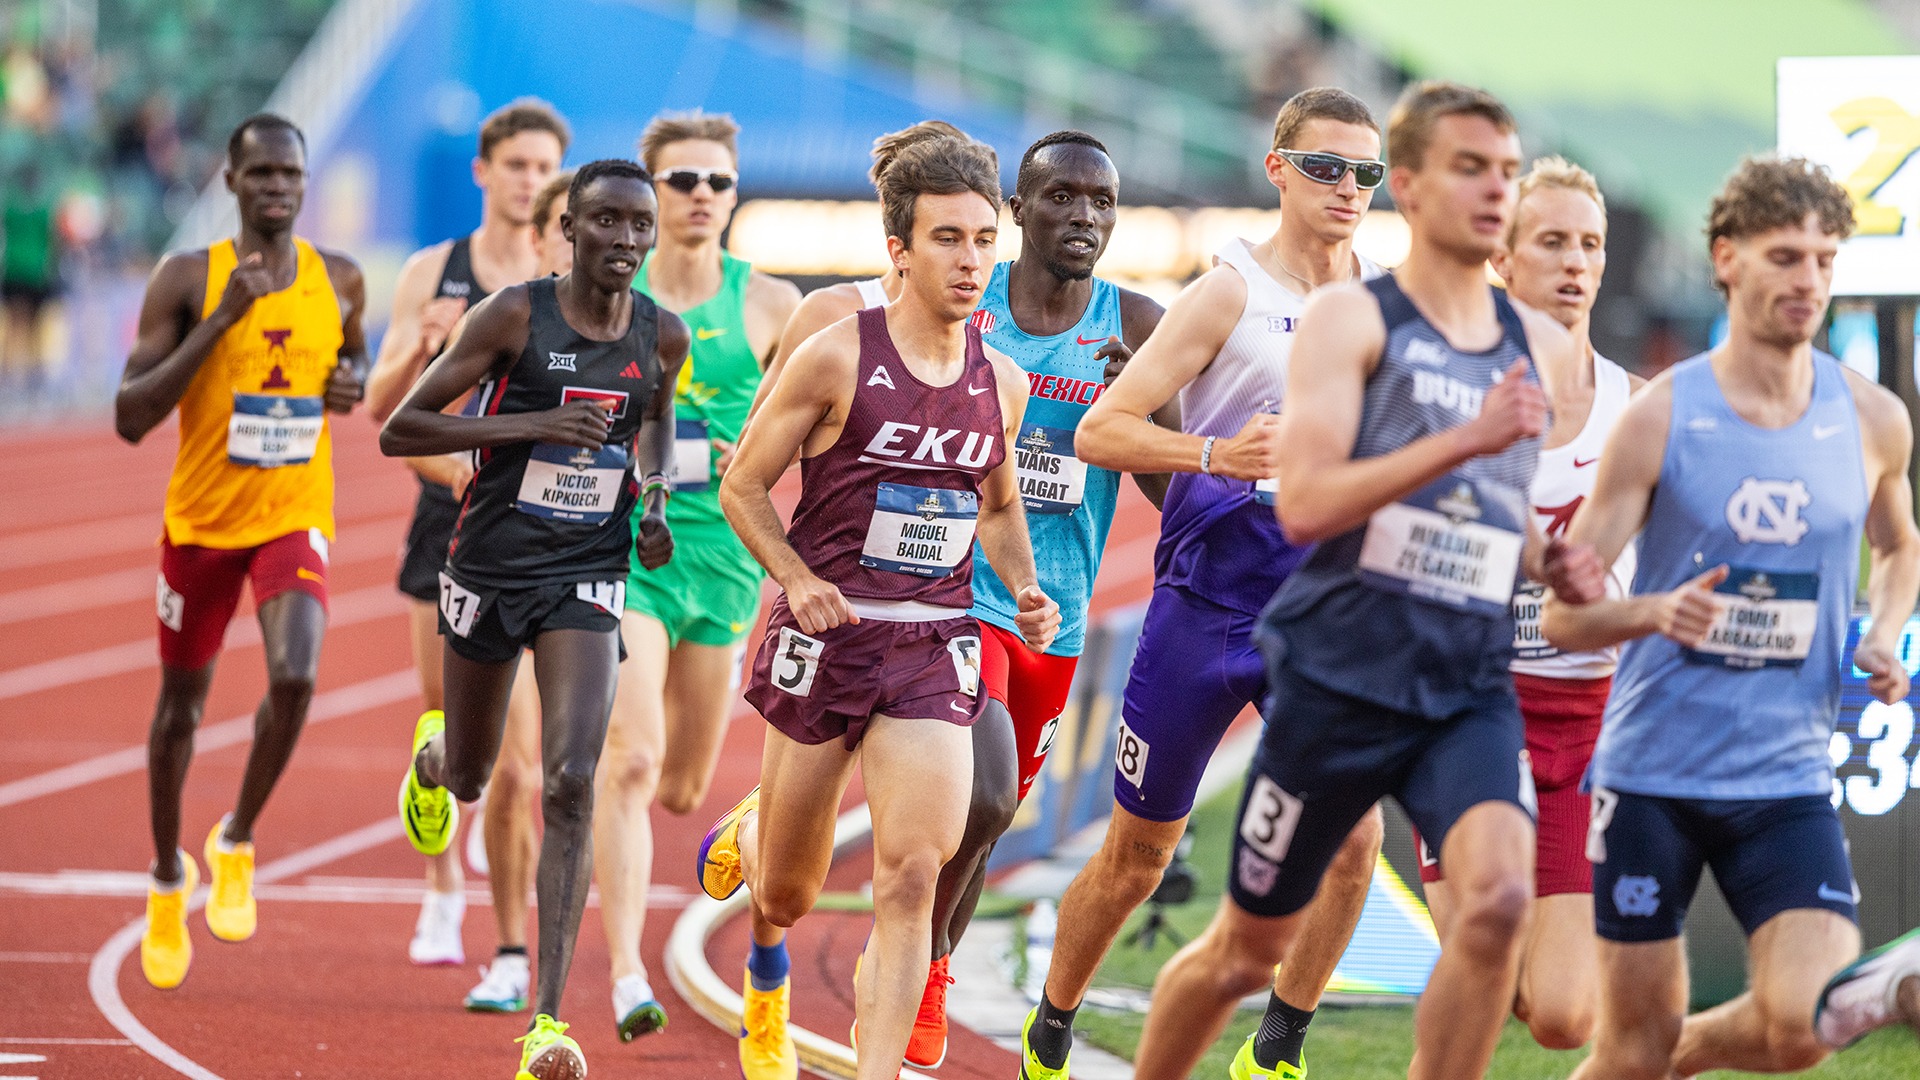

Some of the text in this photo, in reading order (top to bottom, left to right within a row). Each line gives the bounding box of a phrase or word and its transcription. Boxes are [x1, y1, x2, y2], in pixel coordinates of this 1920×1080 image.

[864, 421, 995, 468] EKU
[1016, 451, 1062, 475] VANS
[556, 472, 598, 490] VICTOR
[1018, 476, 1070, 501] LAGAT
[542, 488, 600, 507] KIPKOECH
[900, 522, 948, 542] MIGUEL
[896, 541, 943, 561] BAIDAL
[779, 634, 813, 688] 5
[1117, 725, 1139, 776] 18
[1253, 791, 1283, 843] 3
